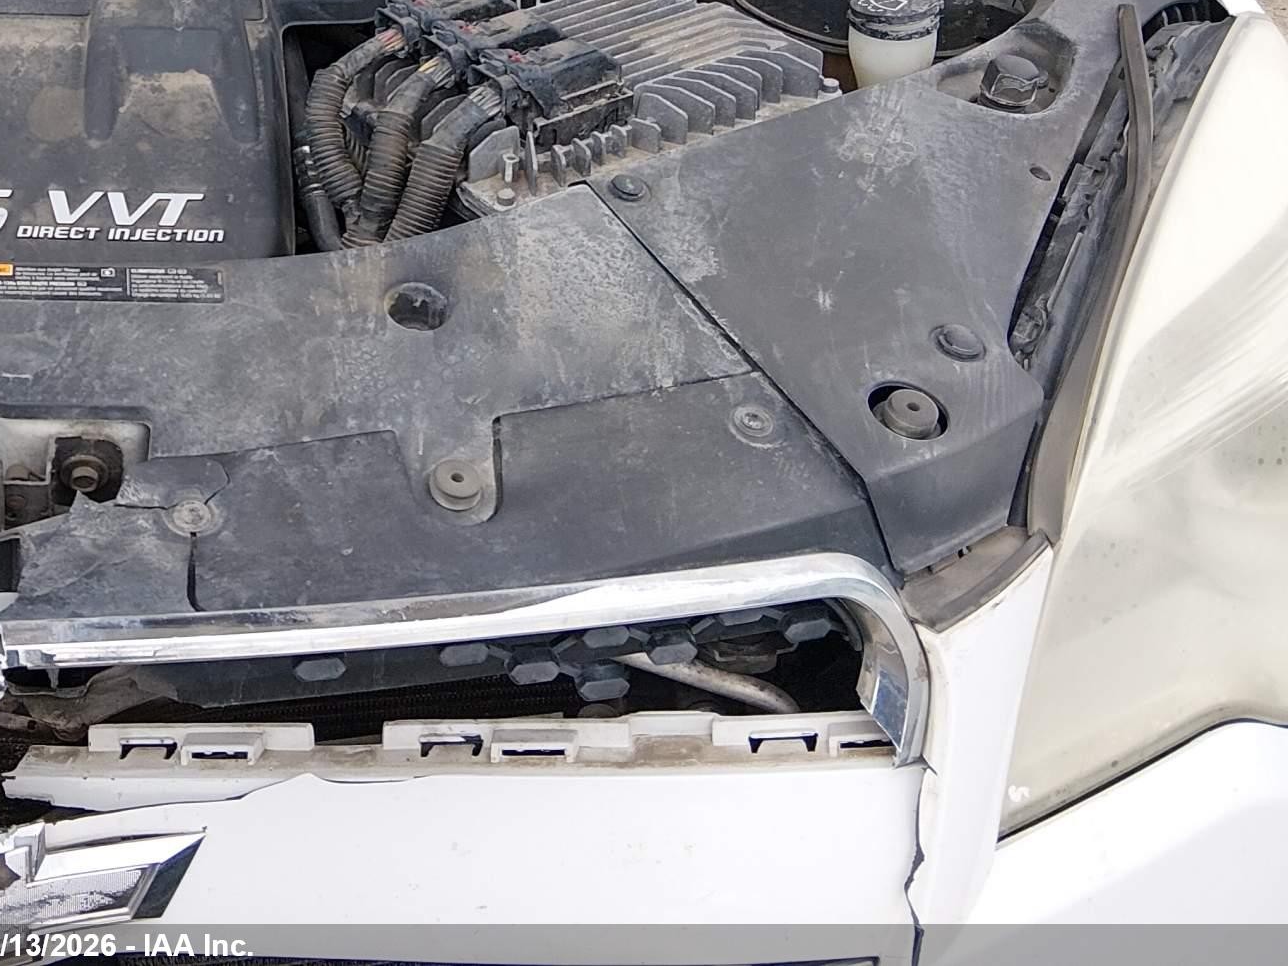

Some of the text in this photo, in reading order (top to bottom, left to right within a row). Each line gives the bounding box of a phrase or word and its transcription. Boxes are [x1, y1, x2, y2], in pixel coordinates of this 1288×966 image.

[48, 190, 204, 226] VVT
[16, 225, 225, 242] DIRECT INJECTION
